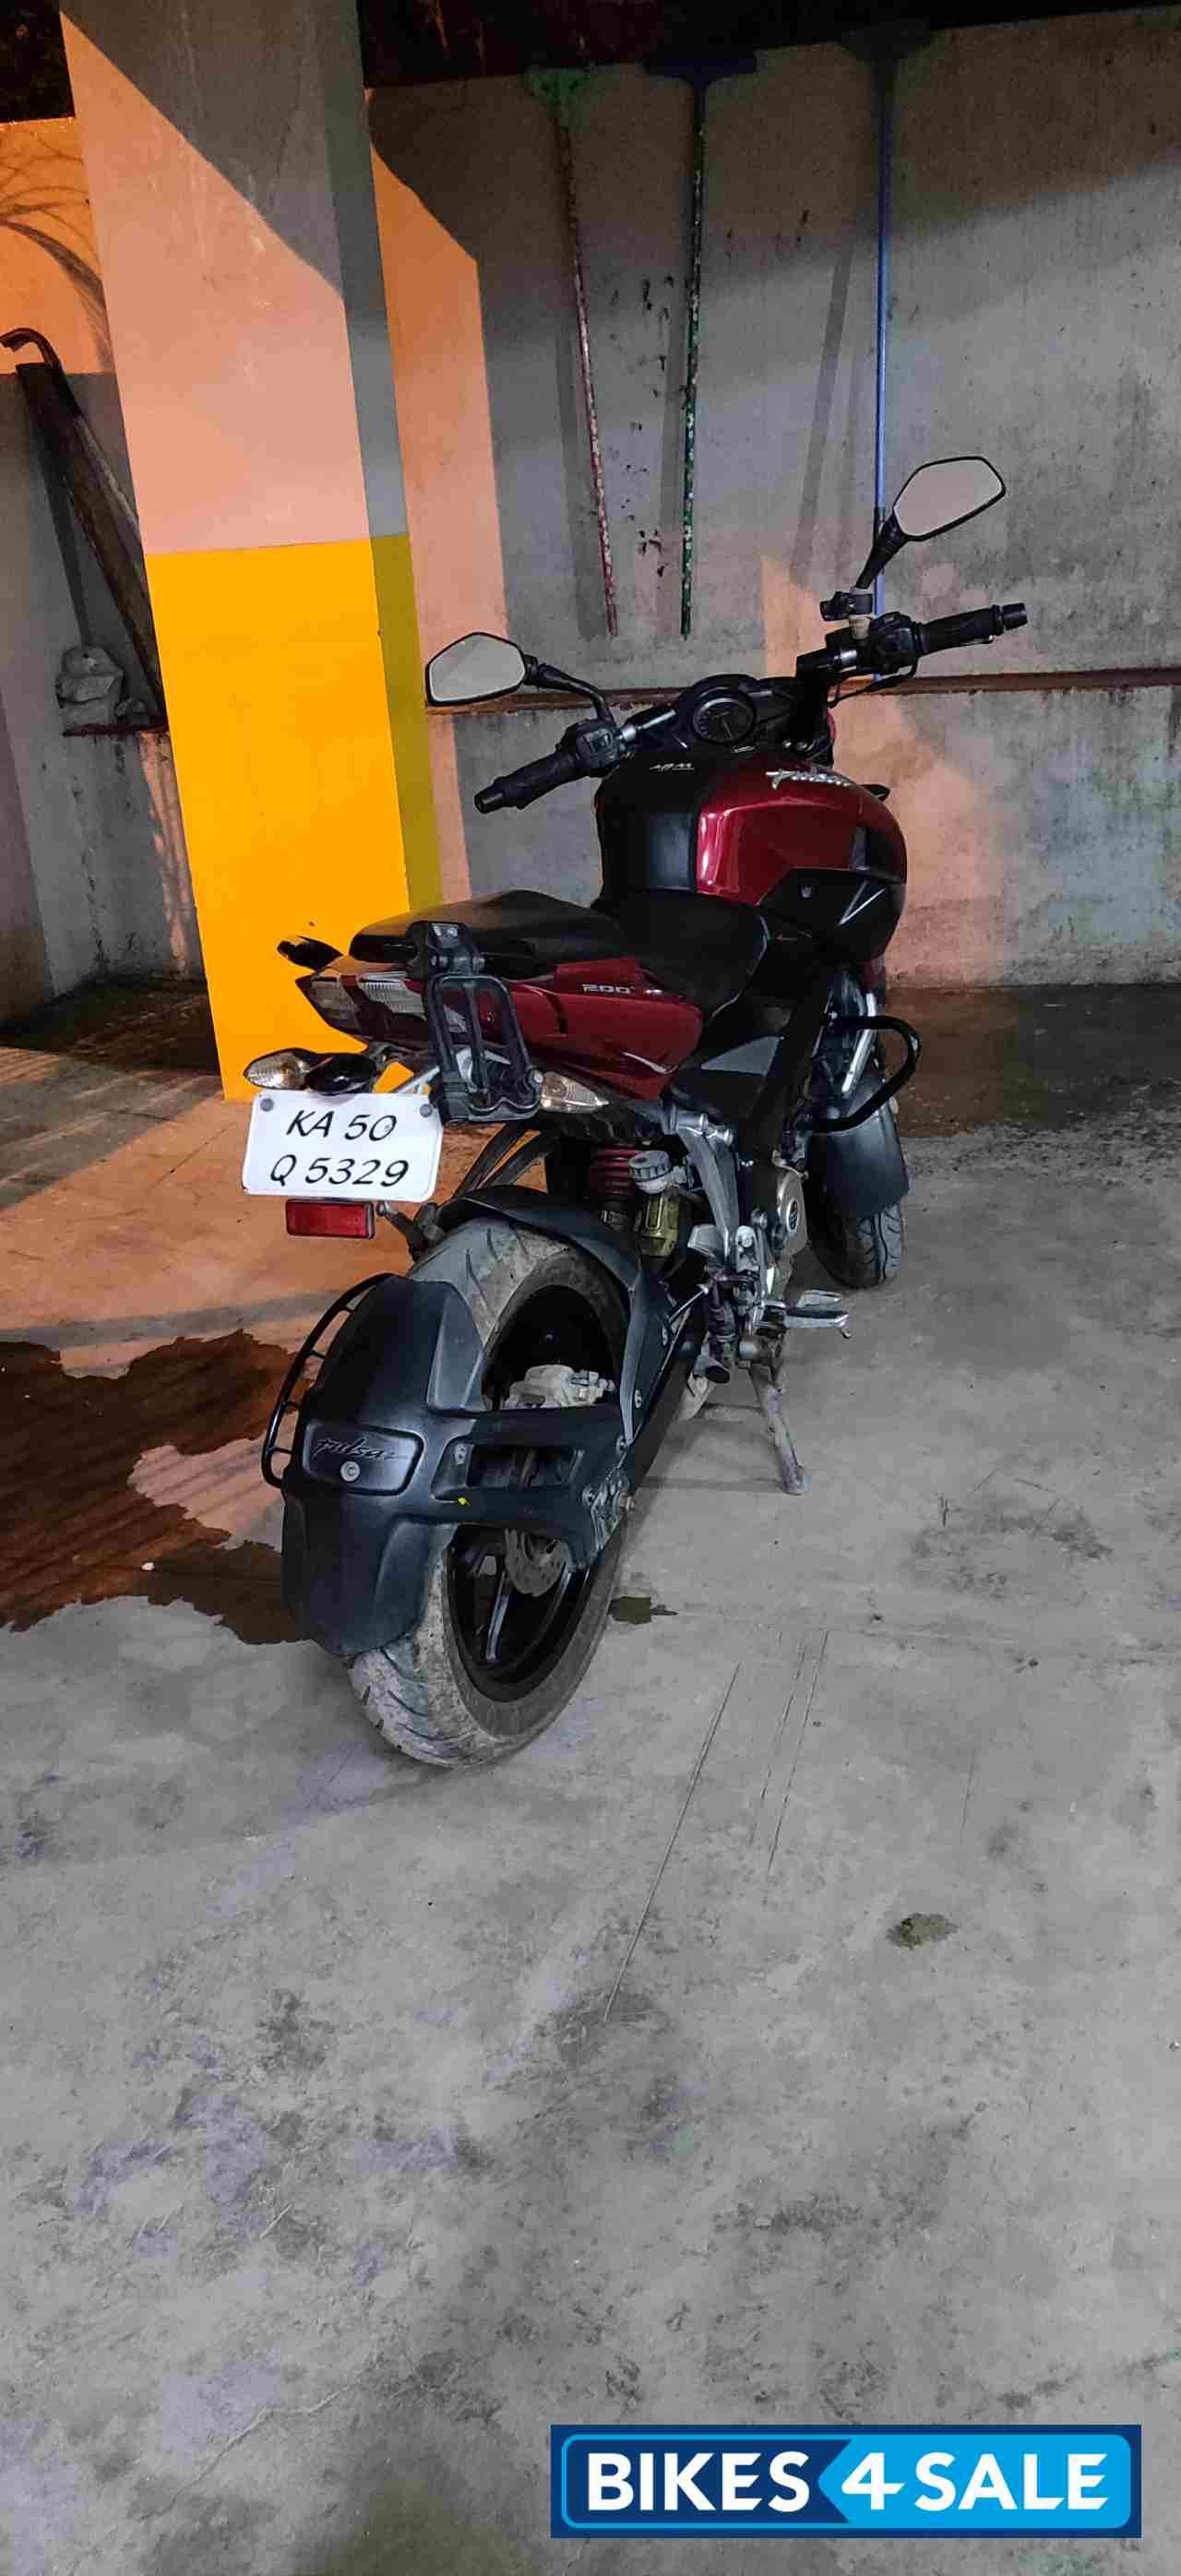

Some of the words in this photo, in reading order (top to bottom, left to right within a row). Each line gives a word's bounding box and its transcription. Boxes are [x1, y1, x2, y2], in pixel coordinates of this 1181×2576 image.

[286, 1110, 335, 1138] KA
[344, 1115, 398, 1141] 50
[269, 1154, 297, 1187] Q
[304, 1157, 410, 1187] 5329
